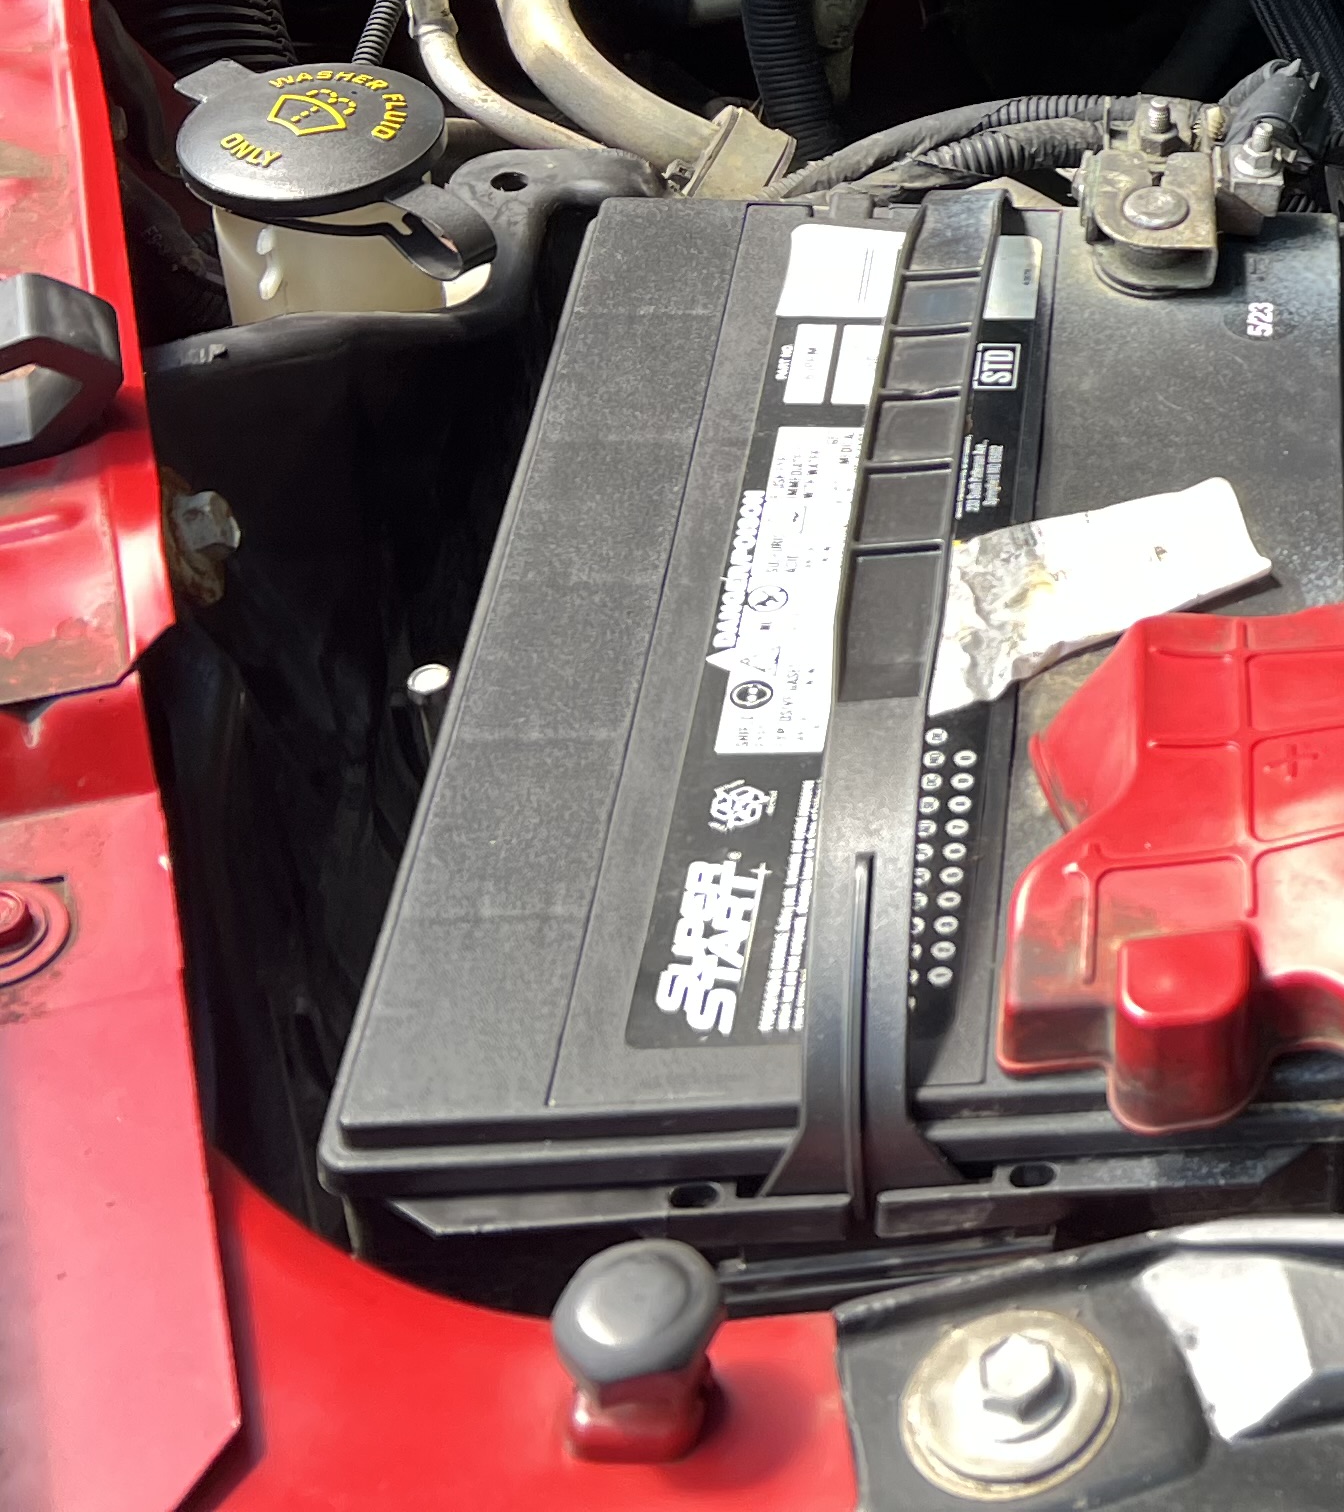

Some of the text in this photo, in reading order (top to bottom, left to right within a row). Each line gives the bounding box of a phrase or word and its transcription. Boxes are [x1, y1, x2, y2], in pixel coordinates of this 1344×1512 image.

[268, 70, 408, 141] WASHER FLUID
[220, 132, 283, 168] ONLY
[1246, 302, 1274, 337] 5/23
[980, 349, 1015, 384] STD
[655, 860, 722, 1012] SUPER
[685, 859, 760, 1034] START
